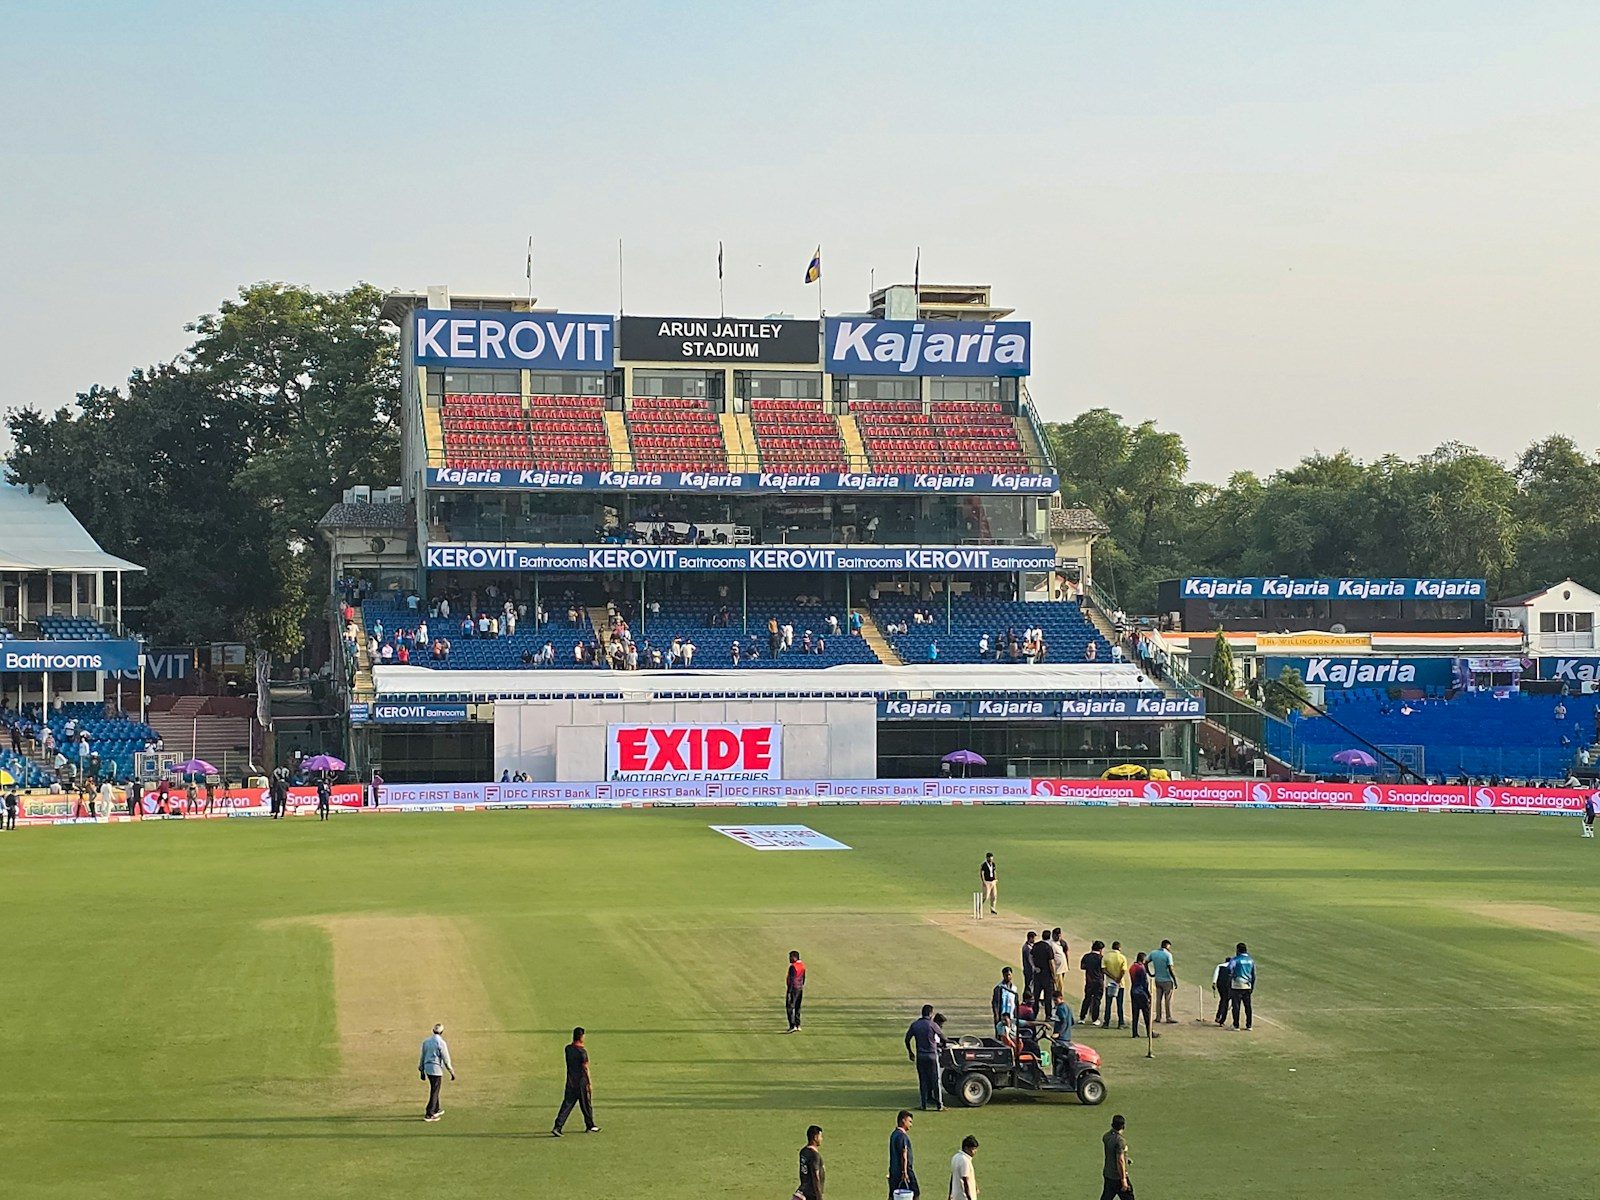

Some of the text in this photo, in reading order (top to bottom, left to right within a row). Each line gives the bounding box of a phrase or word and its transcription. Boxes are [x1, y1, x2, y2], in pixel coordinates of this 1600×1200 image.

[658, 322, 783, 339] ARUN JAITLEY
[417, 318, 610, 361] KEROVIT
[832, 322, 1026, 372] Kajaria
[682, 342, 759, 358] STADIUM
[436, 468, 1052, 491] Kajaria Kajaria Kajaria Kajaria Kajaria Kajaria Kajaria Kajaria
[427, 549, 1055, 569] KEROVIT Bathrooms KEROVIT Bathrooms KEROVIT Bathrooms KEROVIT Bathrooms
[1185, 579, 1481, 598] Kajaria Kajaria Kajaria Kajaria
[6, 653, 102, 668] Bathrooms
[1306, 658, 1416, 688] Kajaria
[375, 706, 426, 718] KEROVIT
[886, 698, 1200, 717] Kajaria Kajaria Kajaria Kajaria
[616, 727, 772, 771] EXIDE
[619, 773, 769, 781] MOTORCYCLE BATTERIES
[391, 790, 479, 801] IDFC FIRST Bank
[503, 789, 590, 799] IDFC FIRST Bank
[615, 787, 701, 797] IDFC FIRST Bank
[725, 786, 811, 796] IDFC FIRST Bank
[834, 786, 918, 795] IDFC FIRST Bank
[942, 785, 1028, 794] IDFC FIRST Bank
[1060, 785, 1133, 798] Snapdragon
[1168, 786, 1242, 800] Snapdragon
[1277, 787, 1353, 802] Snapdragon
[1388, 789, 1465, 805] Snapdragon
[1501, 792, 1580, 808] Snapdragon
